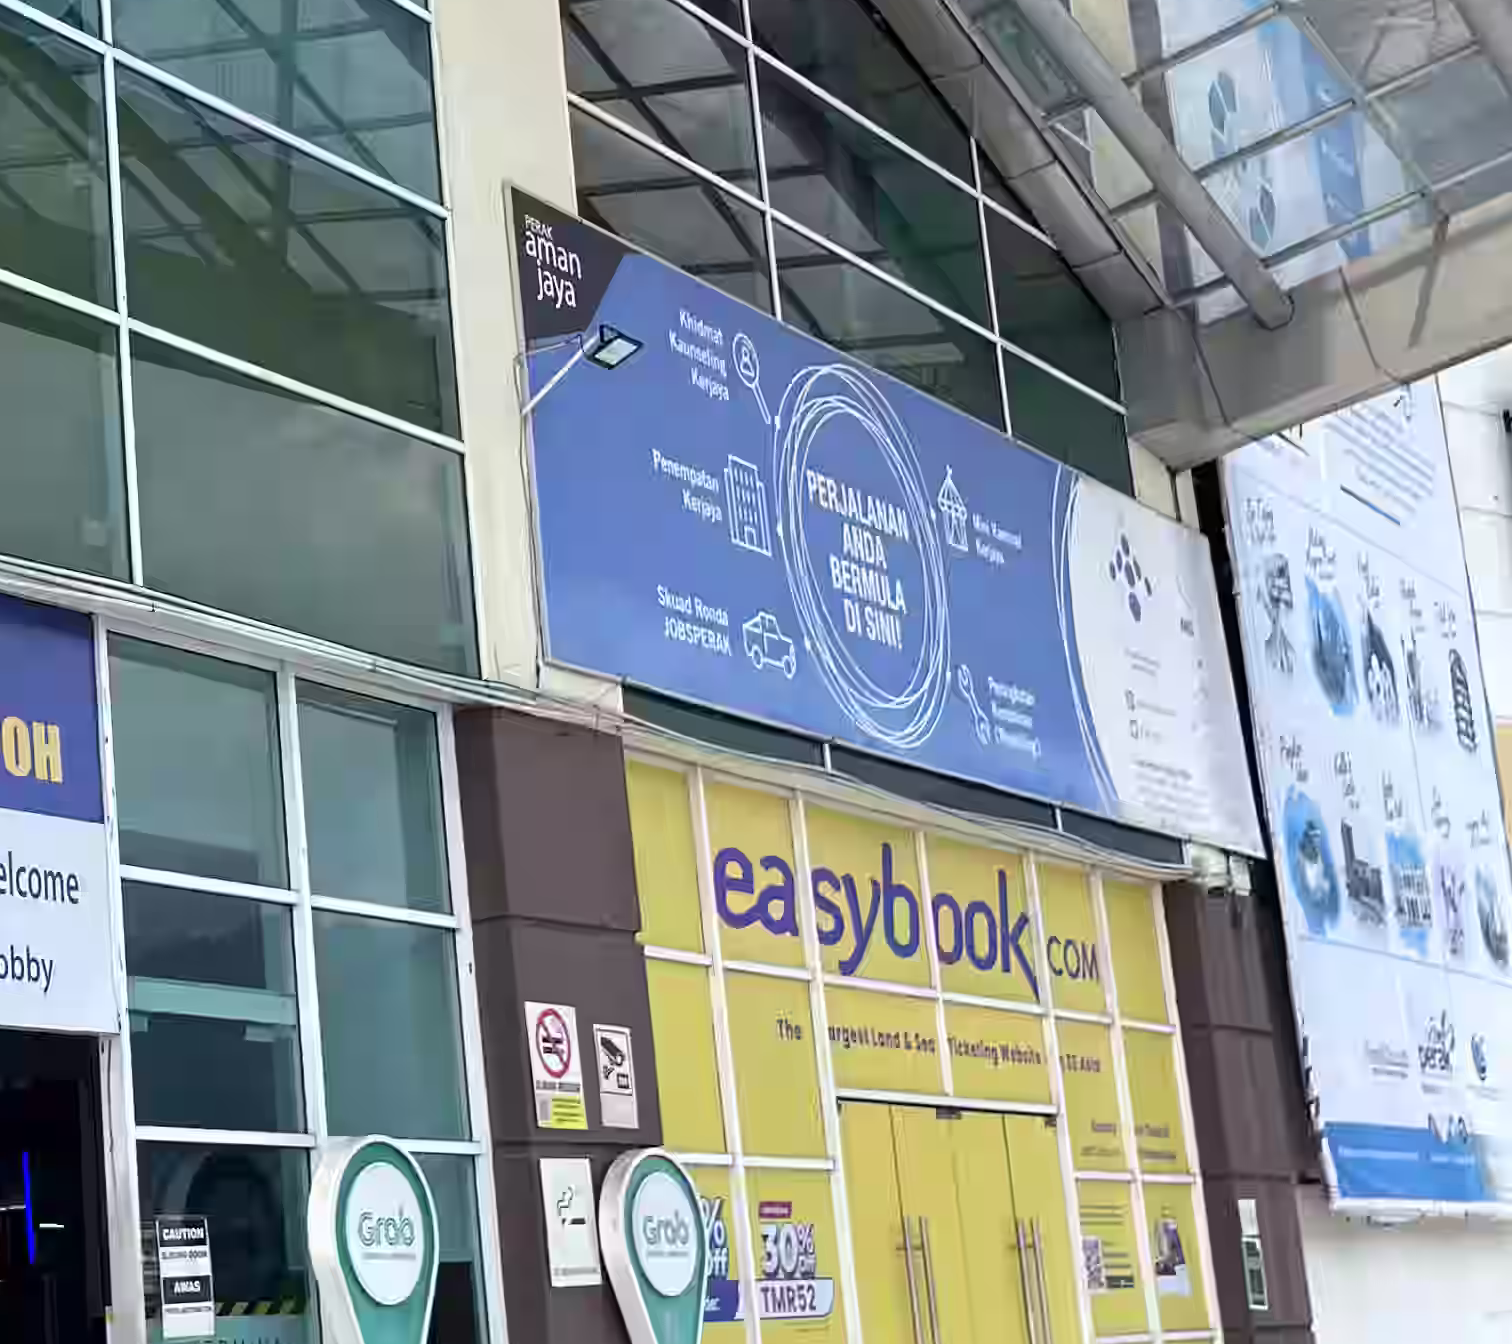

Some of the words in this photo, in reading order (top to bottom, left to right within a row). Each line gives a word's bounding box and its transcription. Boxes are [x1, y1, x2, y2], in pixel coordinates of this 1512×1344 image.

[525, 231, 582, 280] aman
[536, 258, 576, 309] jaya
[679, 309, 723, 346] Khidmat
[668, 329, 727, 377] Kaunseling
[690, 367, 729, 401] Kerjaya
[652, 448, 719, 493] Penempatan
[682, 488, 722, 523] Kerjaya
[806, 469, 909, 542] PERJALANAN
[843, 522, 887, 569] ANDA
[829, 553, 907, 615] BERMULA
[656, 585, 692, 614] Skuad
[694, 596, 728, 627] Ronda
[843, 598, 863, 637] DI
[865, 606, 903, 650] SINI!
[664, 616, 731, 656] JOBSPERAK
[713, 842, 1041, 1004] easybook
[776, 1018, 802, 1041] The
[828, 1025, 869, 1049] argest
[162, 1227, 204, 1241] CAUTION
[357, 1205, 415, 1247] Grab
[643, 1209, 689, 1246] Grab
[173, 1280, 201, 1295] AWAS
[761, 1284, 817, 1313] TMR52
